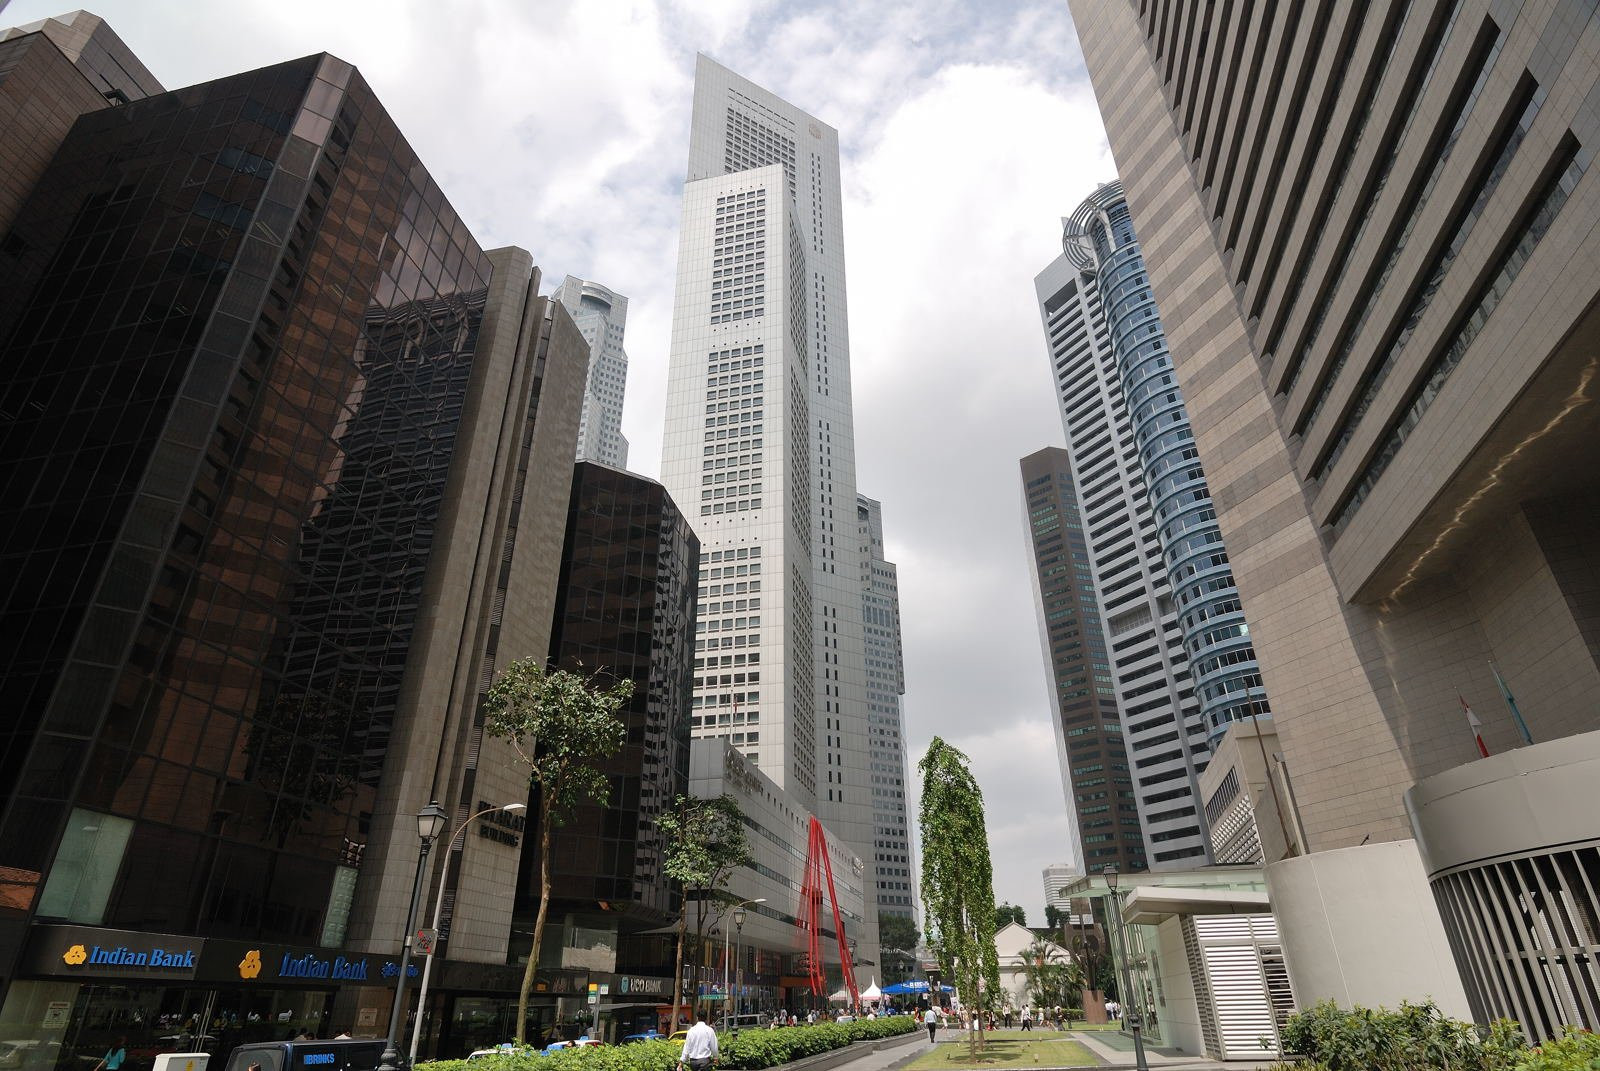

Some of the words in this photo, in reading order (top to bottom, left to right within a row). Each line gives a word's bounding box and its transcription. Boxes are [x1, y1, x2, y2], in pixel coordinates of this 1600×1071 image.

[89, 945, 147, 966] Indian
[149, 949, 195, 968] Bank
[279, 951, 330, 978] Indian
[332, 955, 368, 980] Bank
[645, 979, 662, 993] BANK
